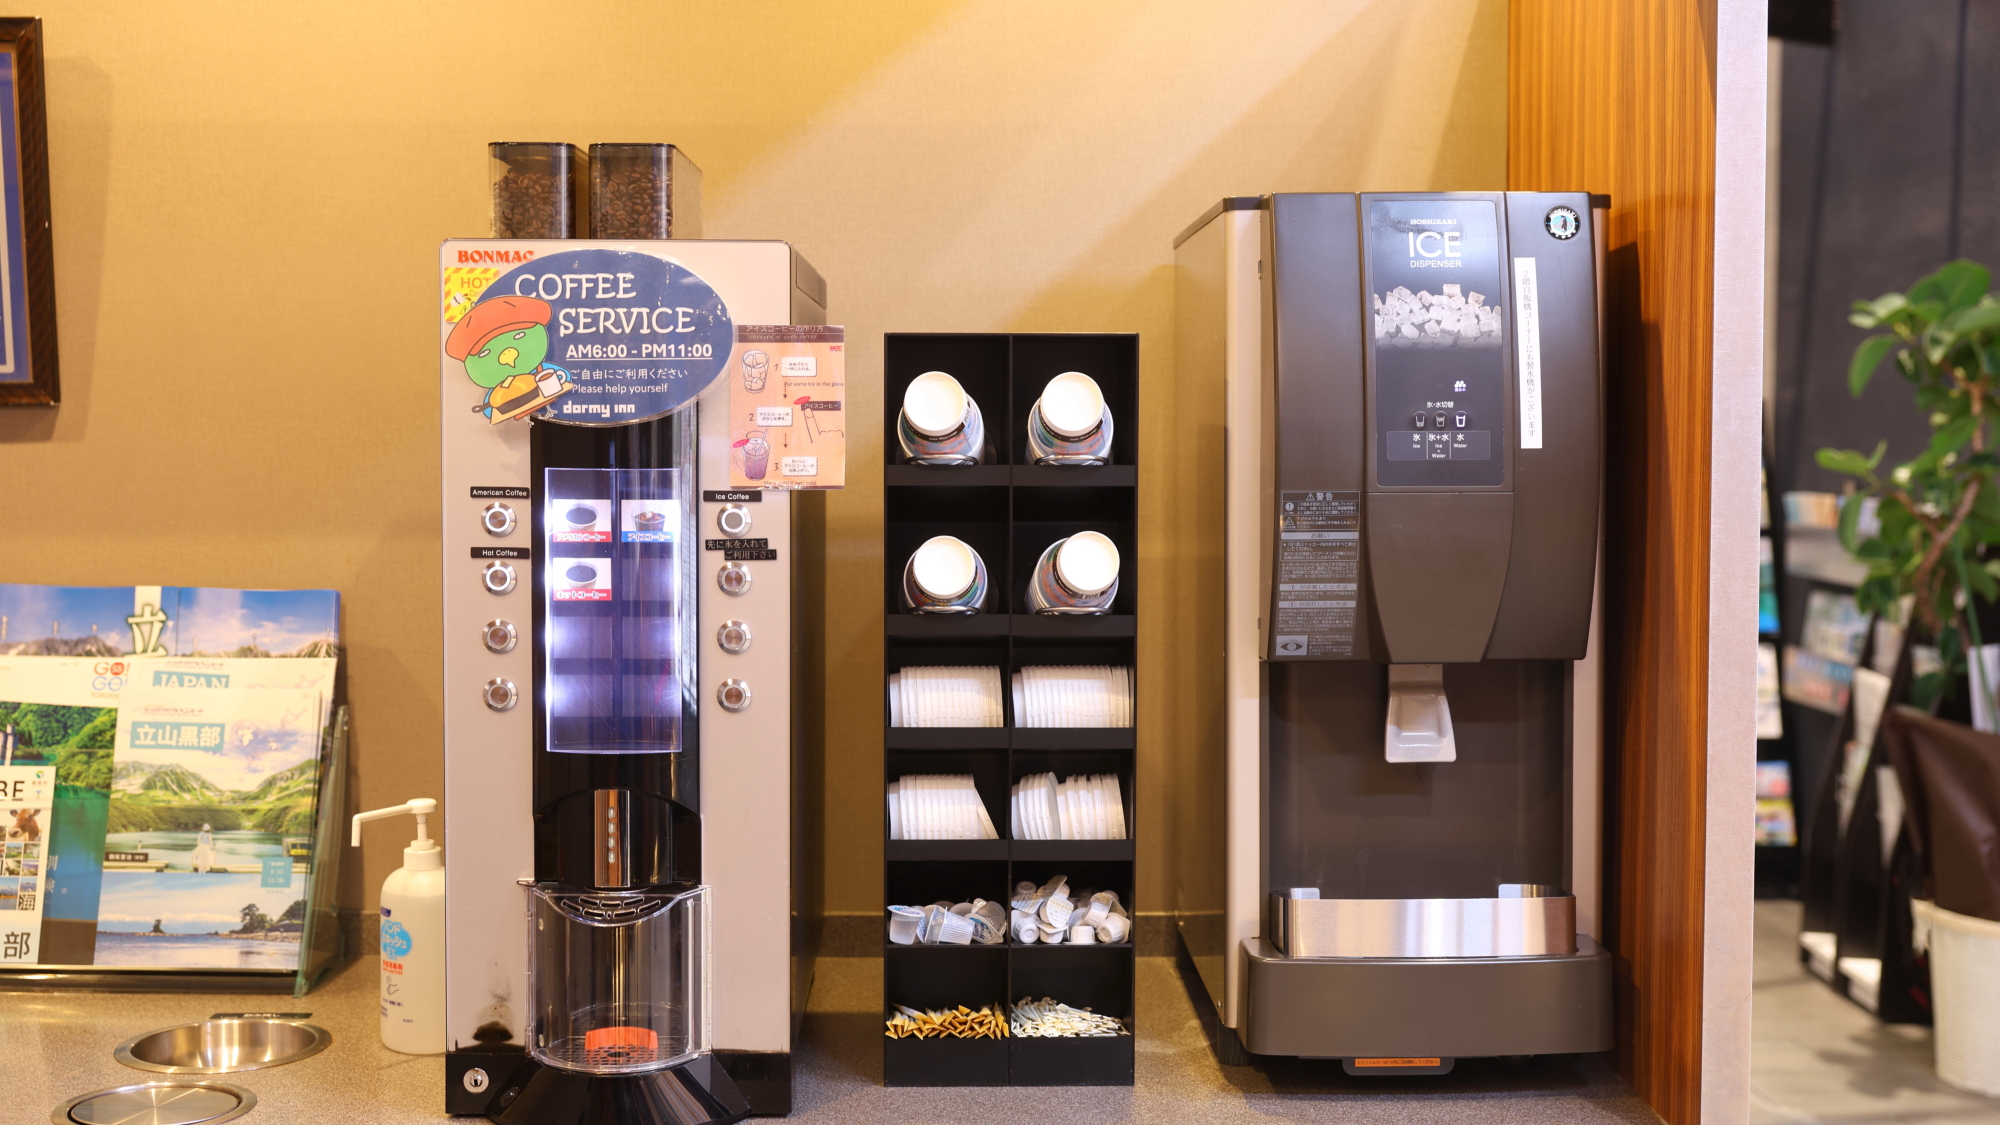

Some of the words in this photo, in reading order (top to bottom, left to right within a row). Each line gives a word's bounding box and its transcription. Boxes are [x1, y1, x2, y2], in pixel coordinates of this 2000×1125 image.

[1408, 231, 1462, 258] ICE
[457, 250, 535, 263] BONMAC
[1410, 260, 1462, 268] DISPENSER
[514, 272, 637, 301] COFFEE
[558, 307, 696, 337] SERVICE
[566, 344, 628, 358] AM6:00
[642, 344, 713, 358] PM11:00
[571, 368, 688, 380] ご自由にご利用ください
[572, 384, 603, 393] Please
[605, 383, 627, 395] help
[629, 383, 669, 395] yourself
[563, 400, 611, 417] dormy
[1412, 433, 1421, 442] 氷
[1456, 433, 1465, 442] 水
[495, 549, 518, 557] Coffee
[724, 550, 776, 560] ご利用下さい
[127, 604, 168, 657] 立
[134, 723, 222, 748] 立山黒部
[3, 930, 31, 960] 部
